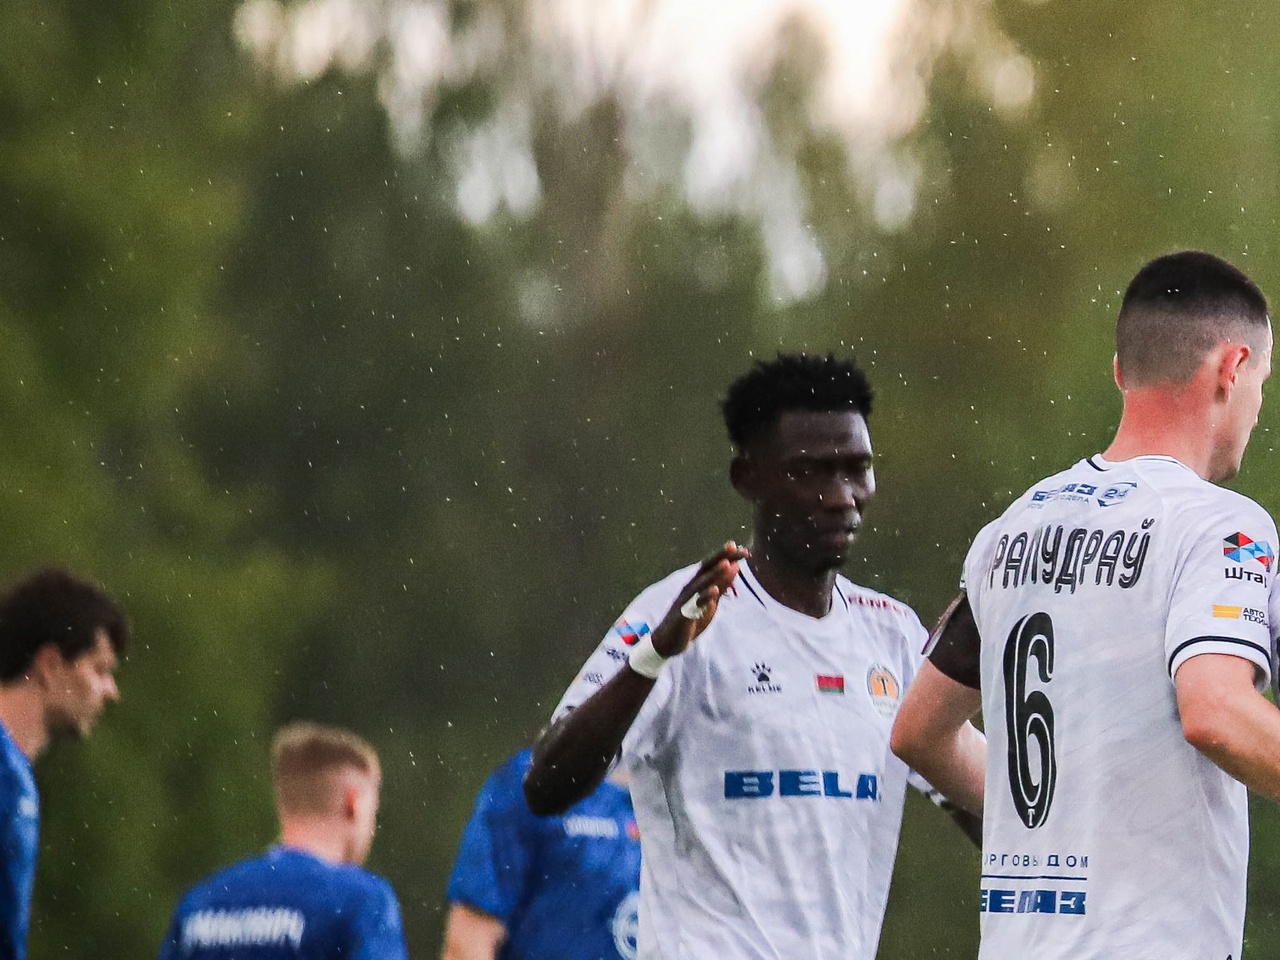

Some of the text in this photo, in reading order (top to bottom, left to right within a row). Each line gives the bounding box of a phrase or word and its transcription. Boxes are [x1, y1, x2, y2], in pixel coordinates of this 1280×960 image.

[1243, 607, 1265, 619] АВТО
[1003, 612, 1056, 829] 6
[724, 771, 879, 801] BELA
[1047, 854, 1088, 868] ДОМ
